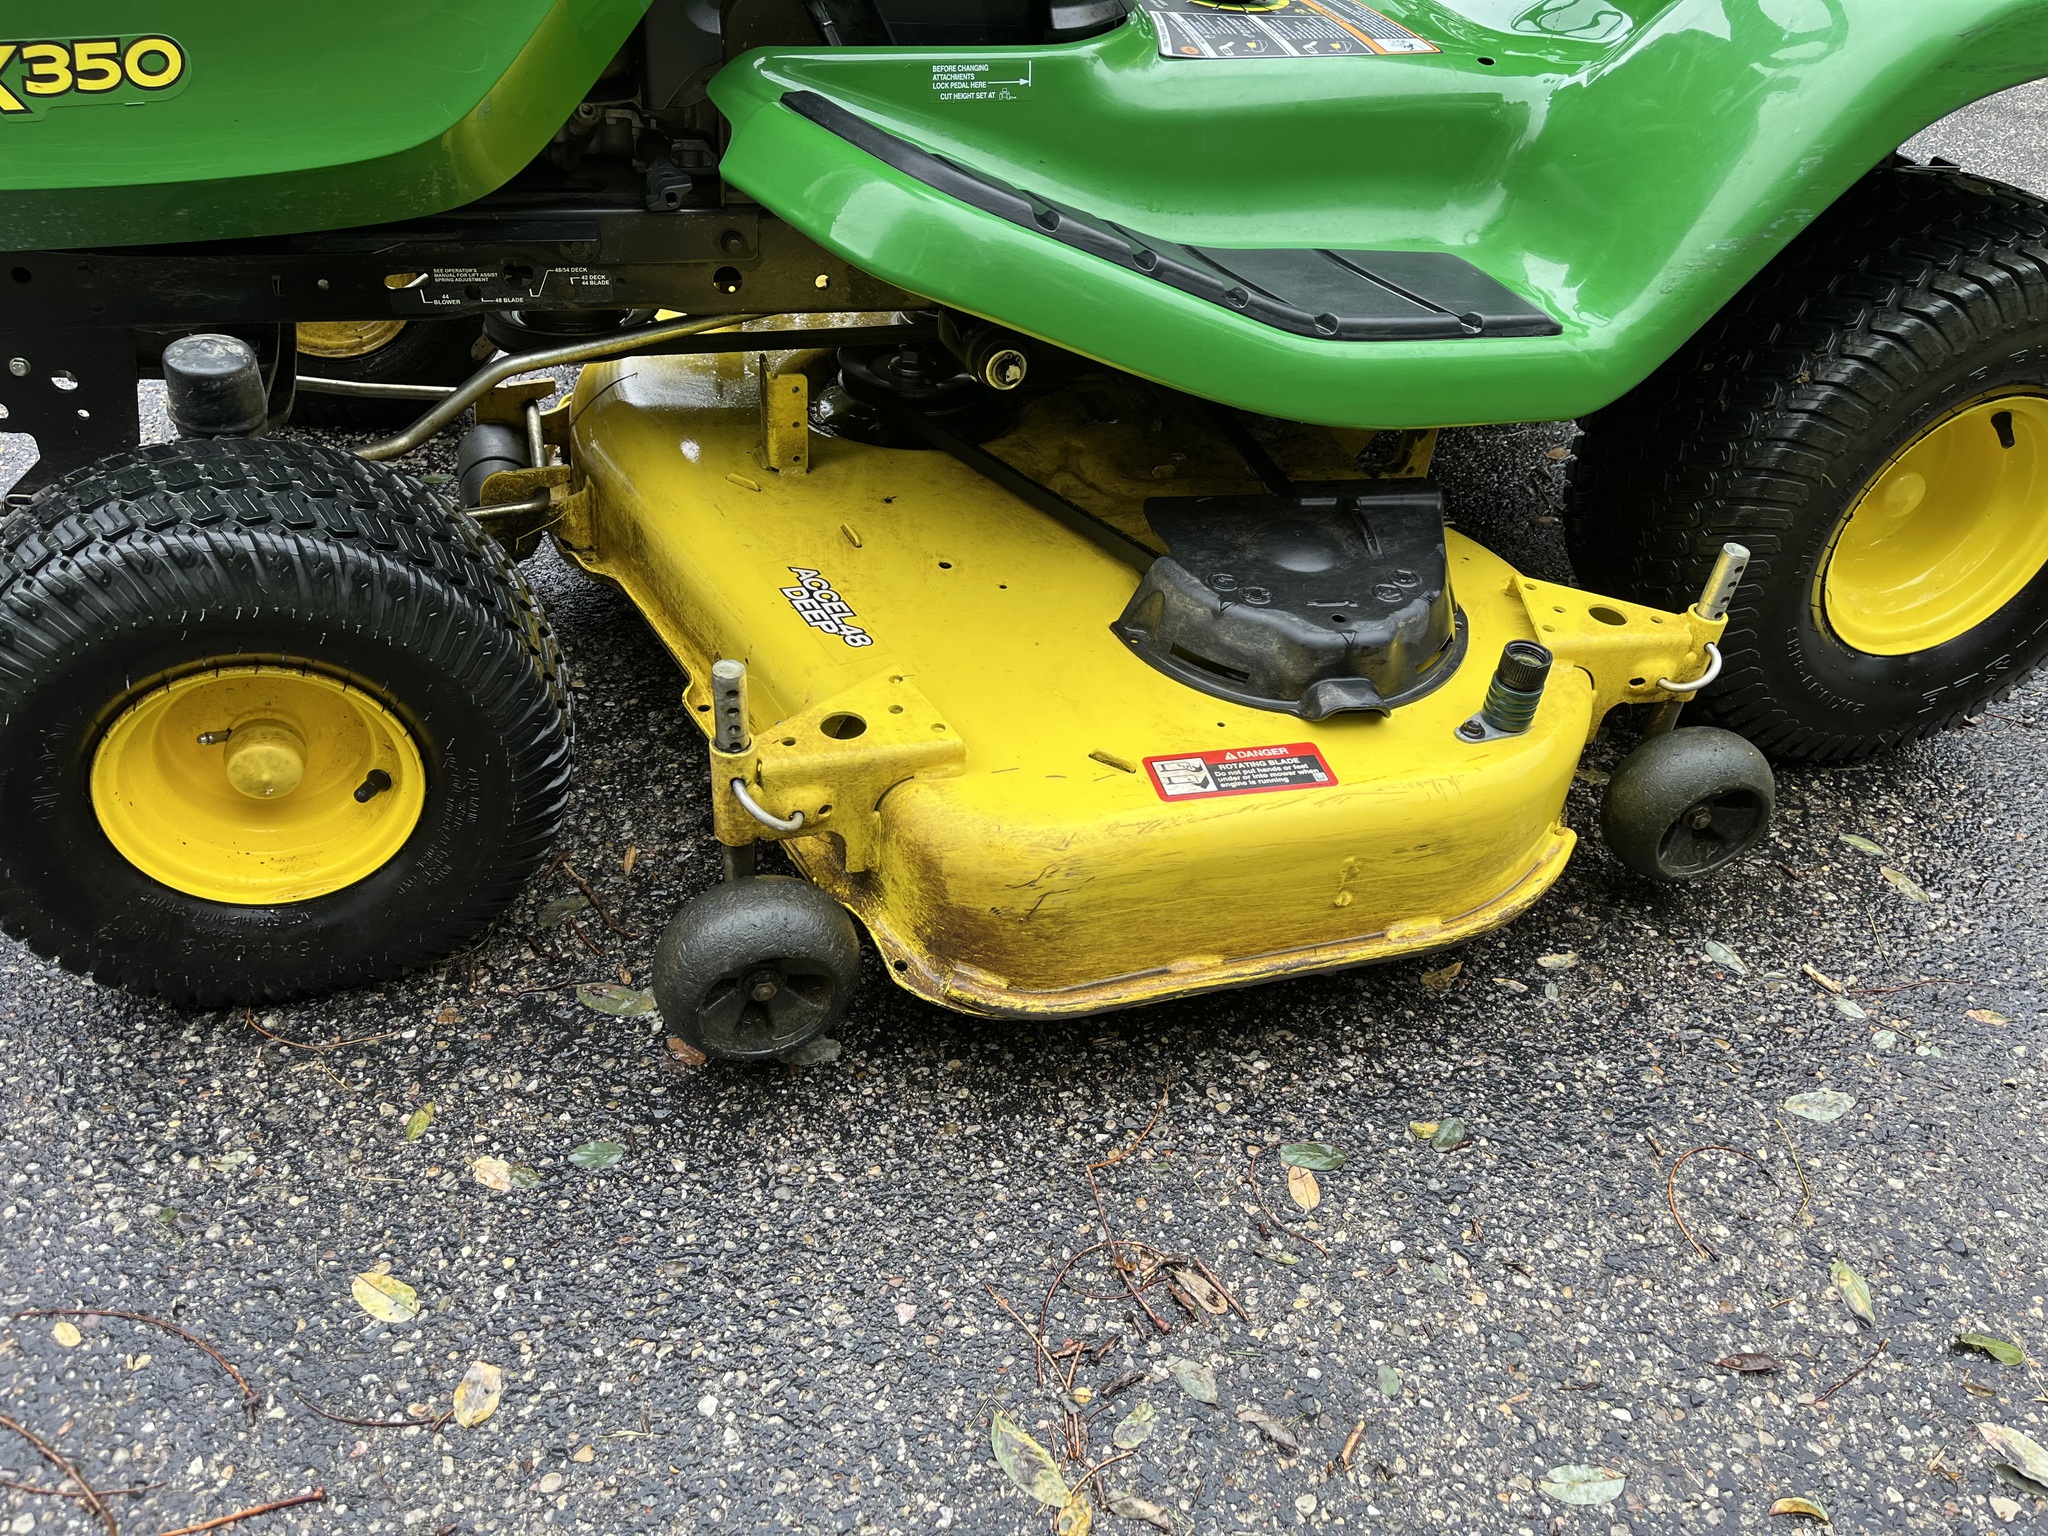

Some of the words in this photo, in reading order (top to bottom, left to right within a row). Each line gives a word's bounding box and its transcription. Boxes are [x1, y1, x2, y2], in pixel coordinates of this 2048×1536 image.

[932, 65, 957, 73] BEFORE
[957, 64, 989, 72] CHANGING
[932, 73, 975, 81] ATTACHMENTS
[932, 82, 949, 90] LOCK
[950, 81, 970, 89] PEDAL
[970, 81, 987, 89] HERE
[940, 92, 952, 100] CUT
[953, 92, 975, 100] HEIGHT
[975, 91, 987, 99] SET
[987, 91, 996, 99] AT
[779, 586, 839, 635] DEEP
[1237, 747, 1289, 759] DANGER
[1218, 761, 1267, 770] ROTATING
[1267, 757, 1300, 766] BLADE
